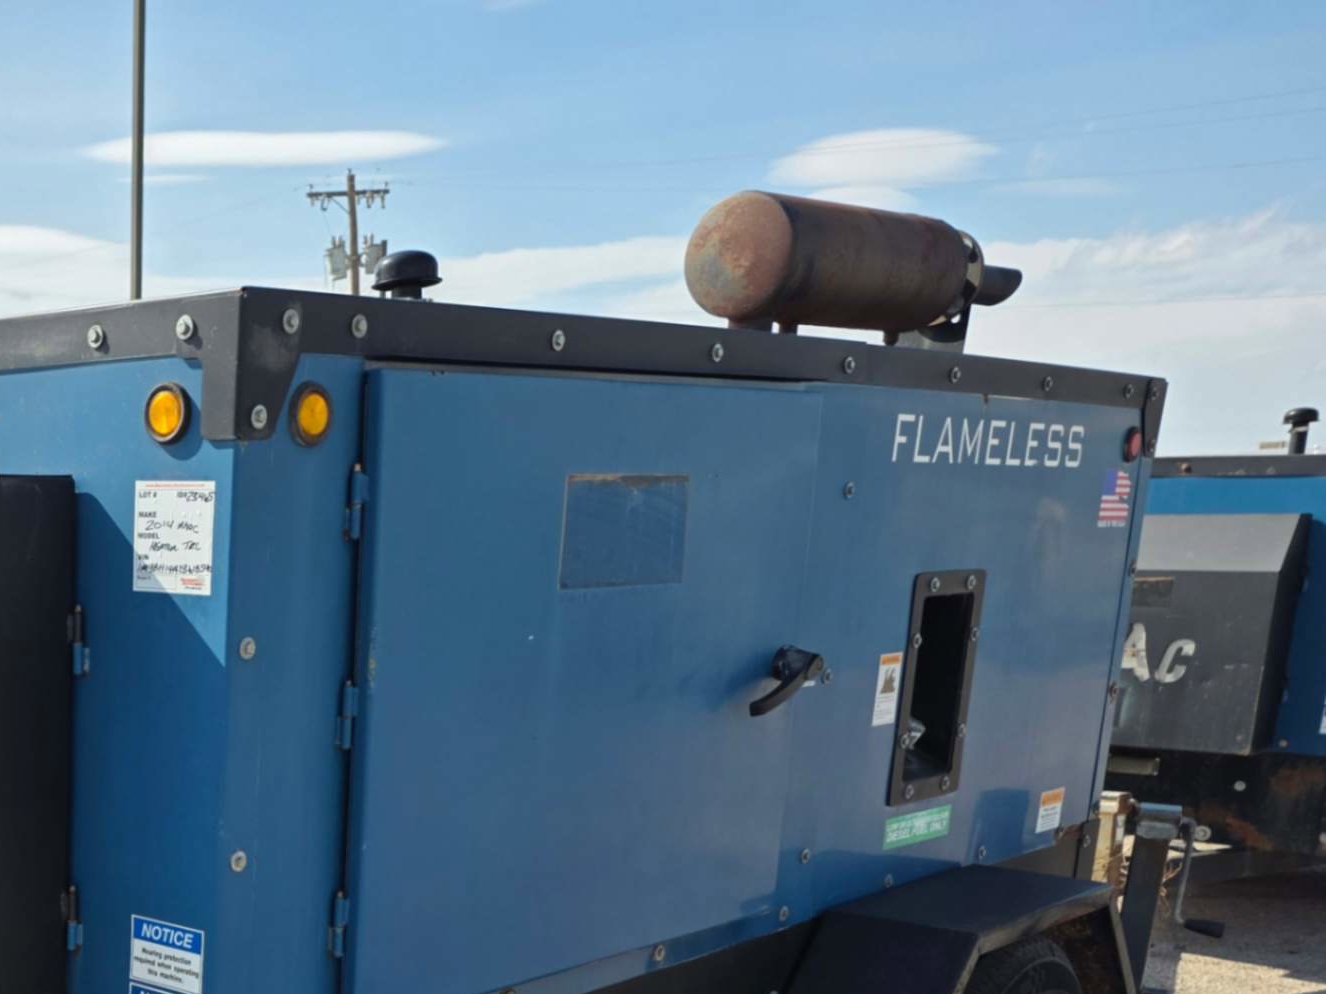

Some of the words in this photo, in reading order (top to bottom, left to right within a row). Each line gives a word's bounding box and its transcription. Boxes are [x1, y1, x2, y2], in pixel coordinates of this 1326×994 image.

[891, 413, 1085, 468] FLAMELESS
[1120, 621, 1197, 684] AC
[141, 923, 194, 949] NOTICE
